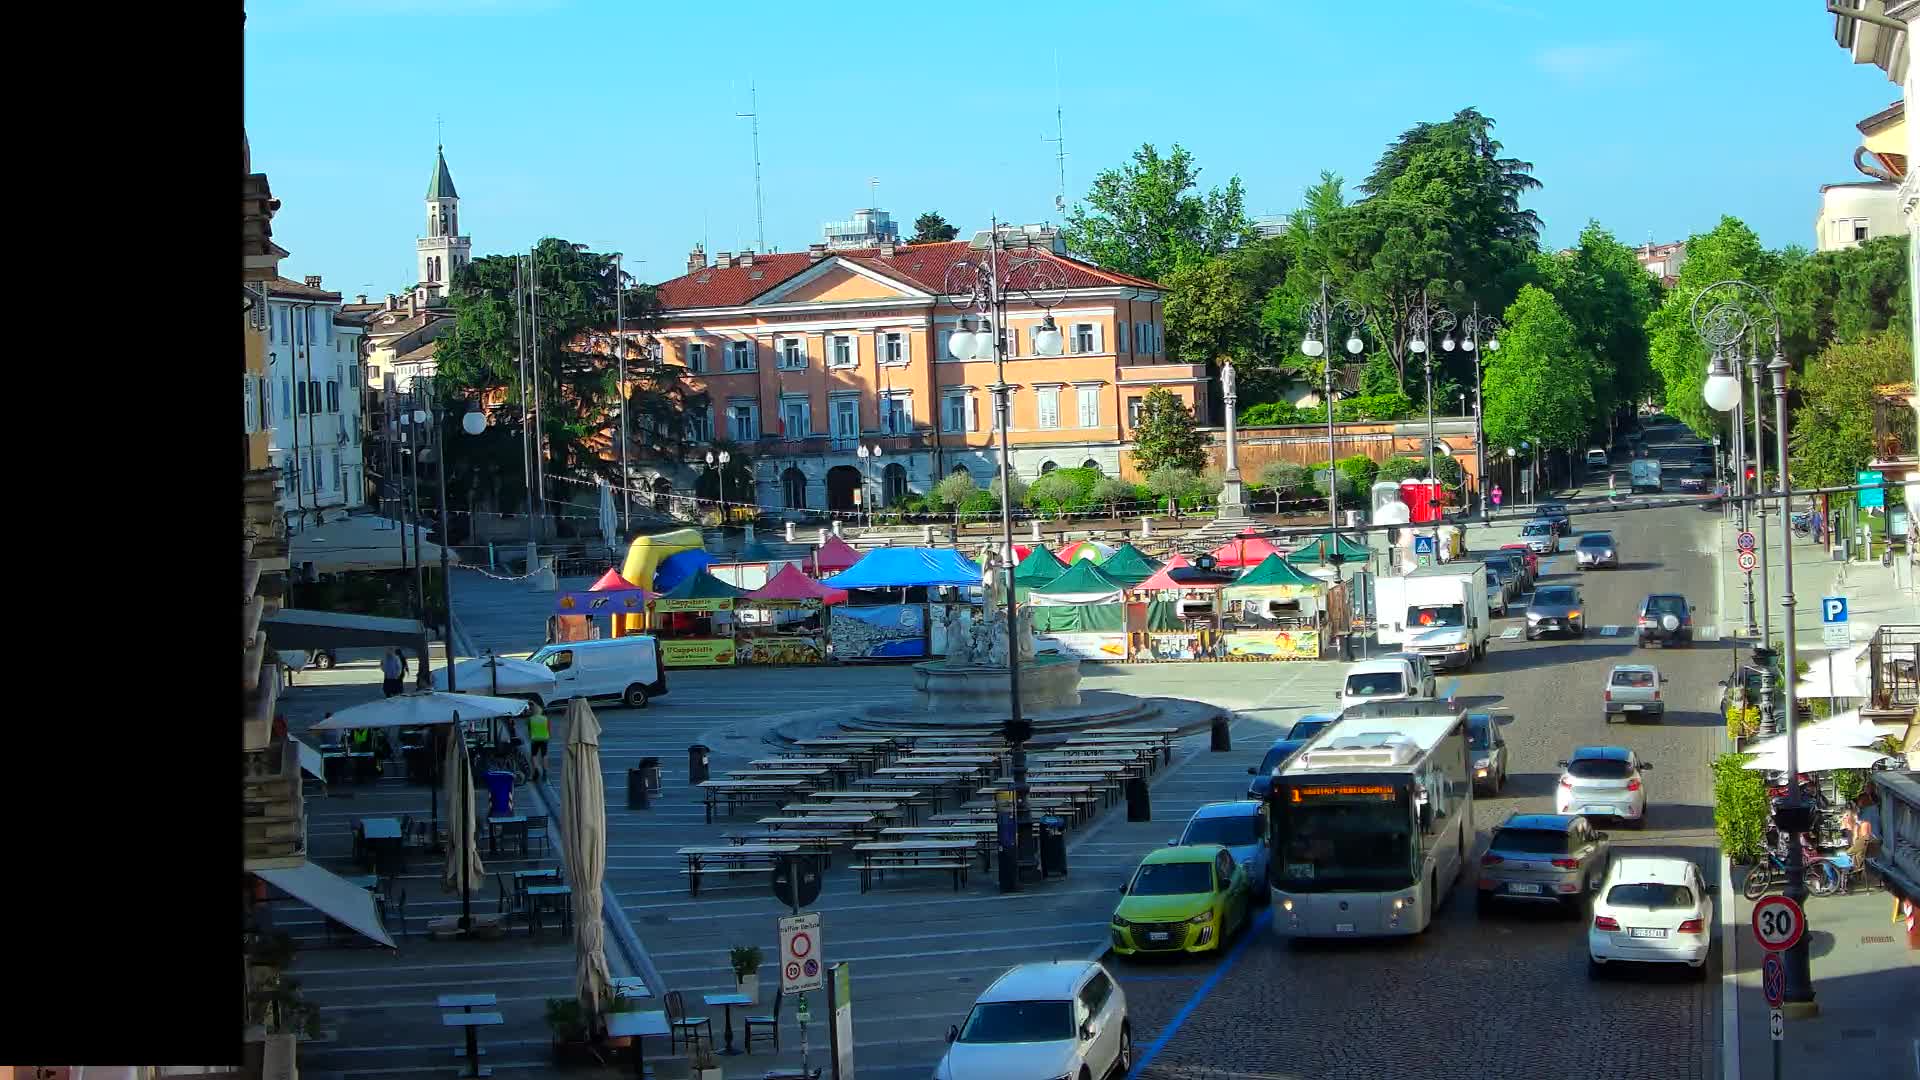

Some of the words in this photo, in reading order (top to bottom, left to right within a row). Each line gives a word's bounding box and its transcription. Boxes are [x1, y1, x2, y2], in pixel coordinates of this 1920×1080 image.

[1827, 600, 1843, 620] P
[1292, 789, 1301, 801] 1
[1761, 910, 1791, 935] 30
